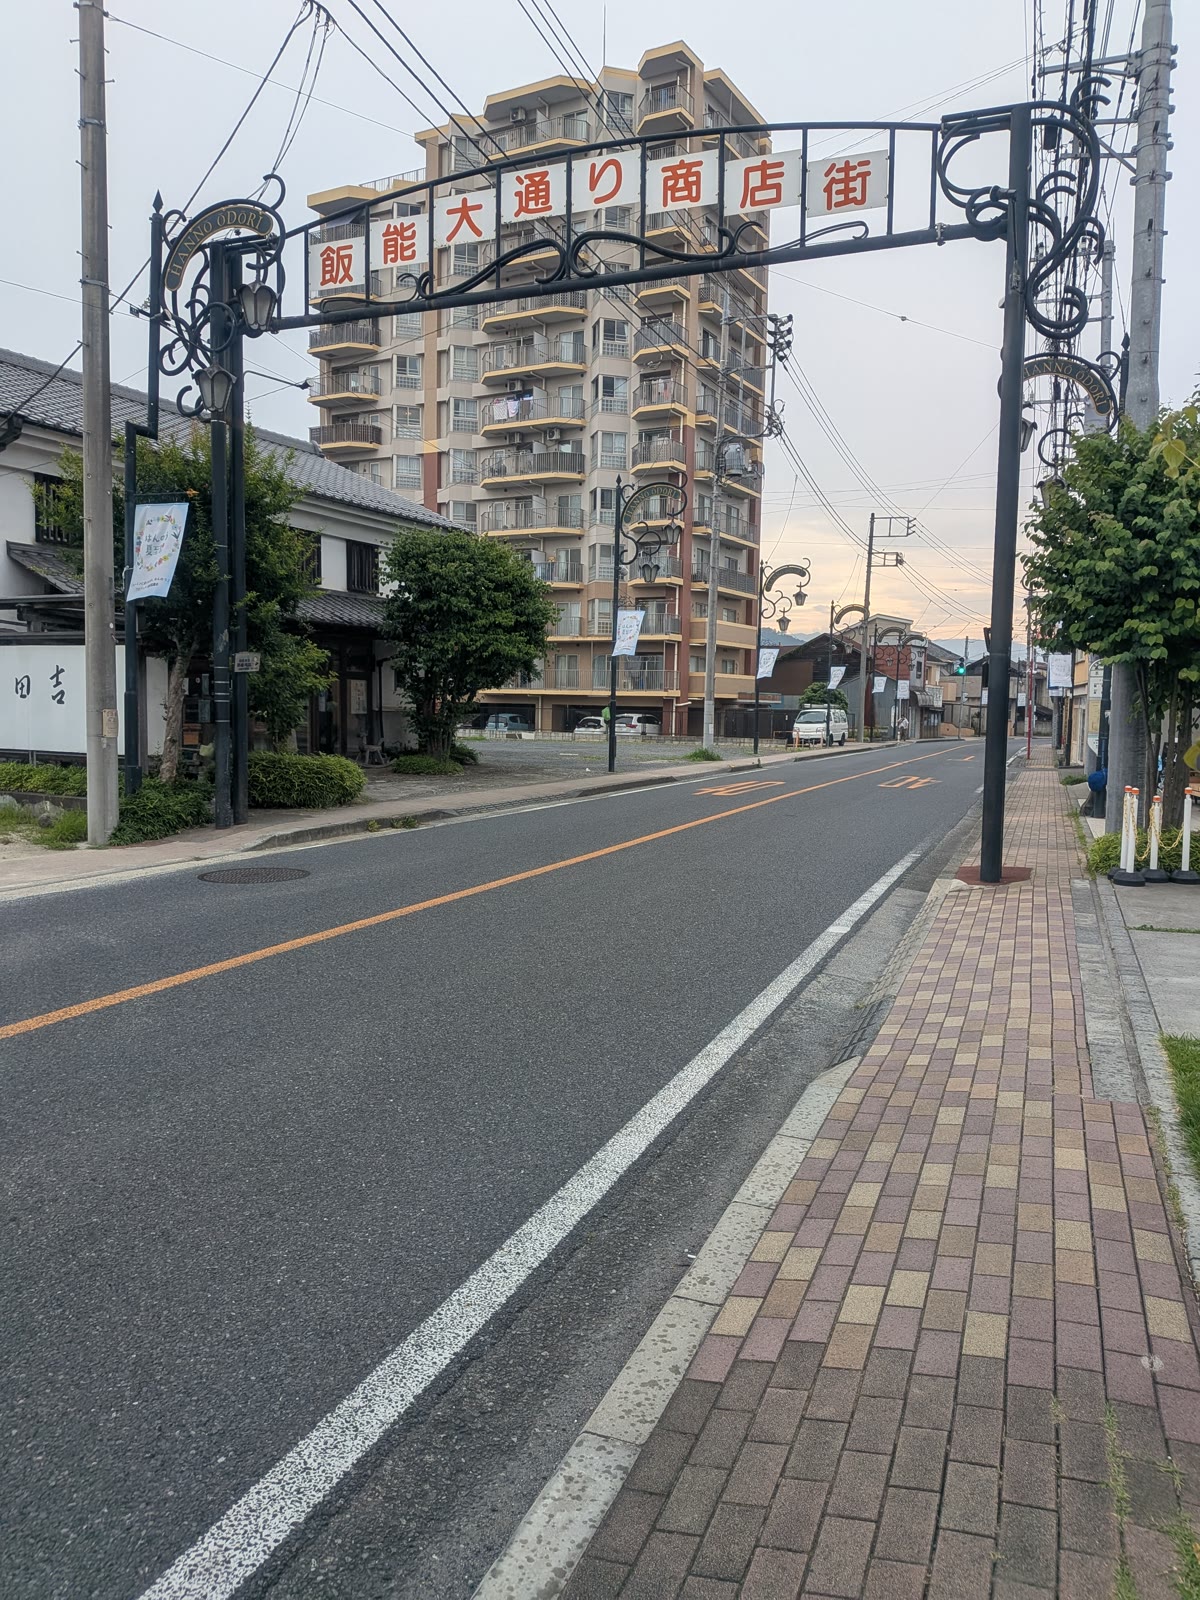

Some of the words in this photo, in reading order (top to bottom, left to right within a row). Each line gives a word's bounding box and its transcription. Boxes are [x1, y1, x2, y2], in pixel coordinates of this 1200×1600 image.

[318, 155, 872, 288] 飯能大通り商店街
